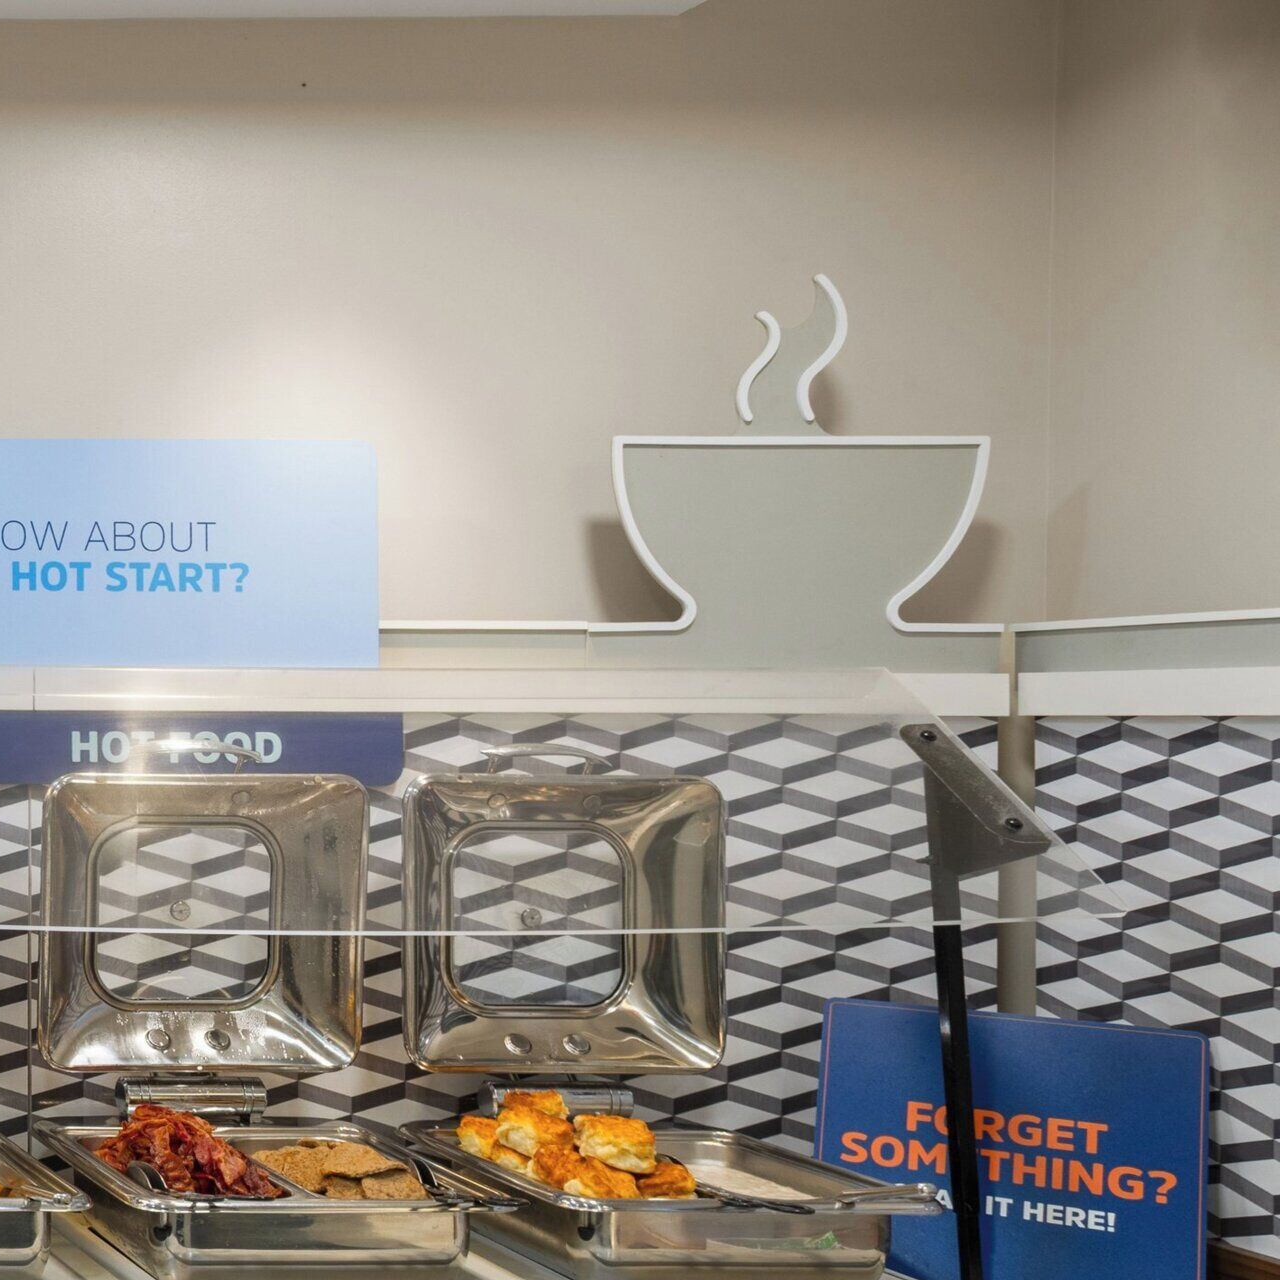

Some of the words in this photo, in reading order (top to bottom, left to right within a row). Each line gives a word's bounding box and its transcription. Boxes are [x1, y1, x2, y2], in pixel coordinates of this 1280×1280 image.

[83, 520, 217, 552] ABOUT
[11, 561, 91, 592] HOT
[103, 561, 251, 593] START?
[840, 1131, 1179, 1204] SOMTHING?
[985, 1195, 1014, 1218] IT
[1022, 1201, 1116, 1233] HERE!
